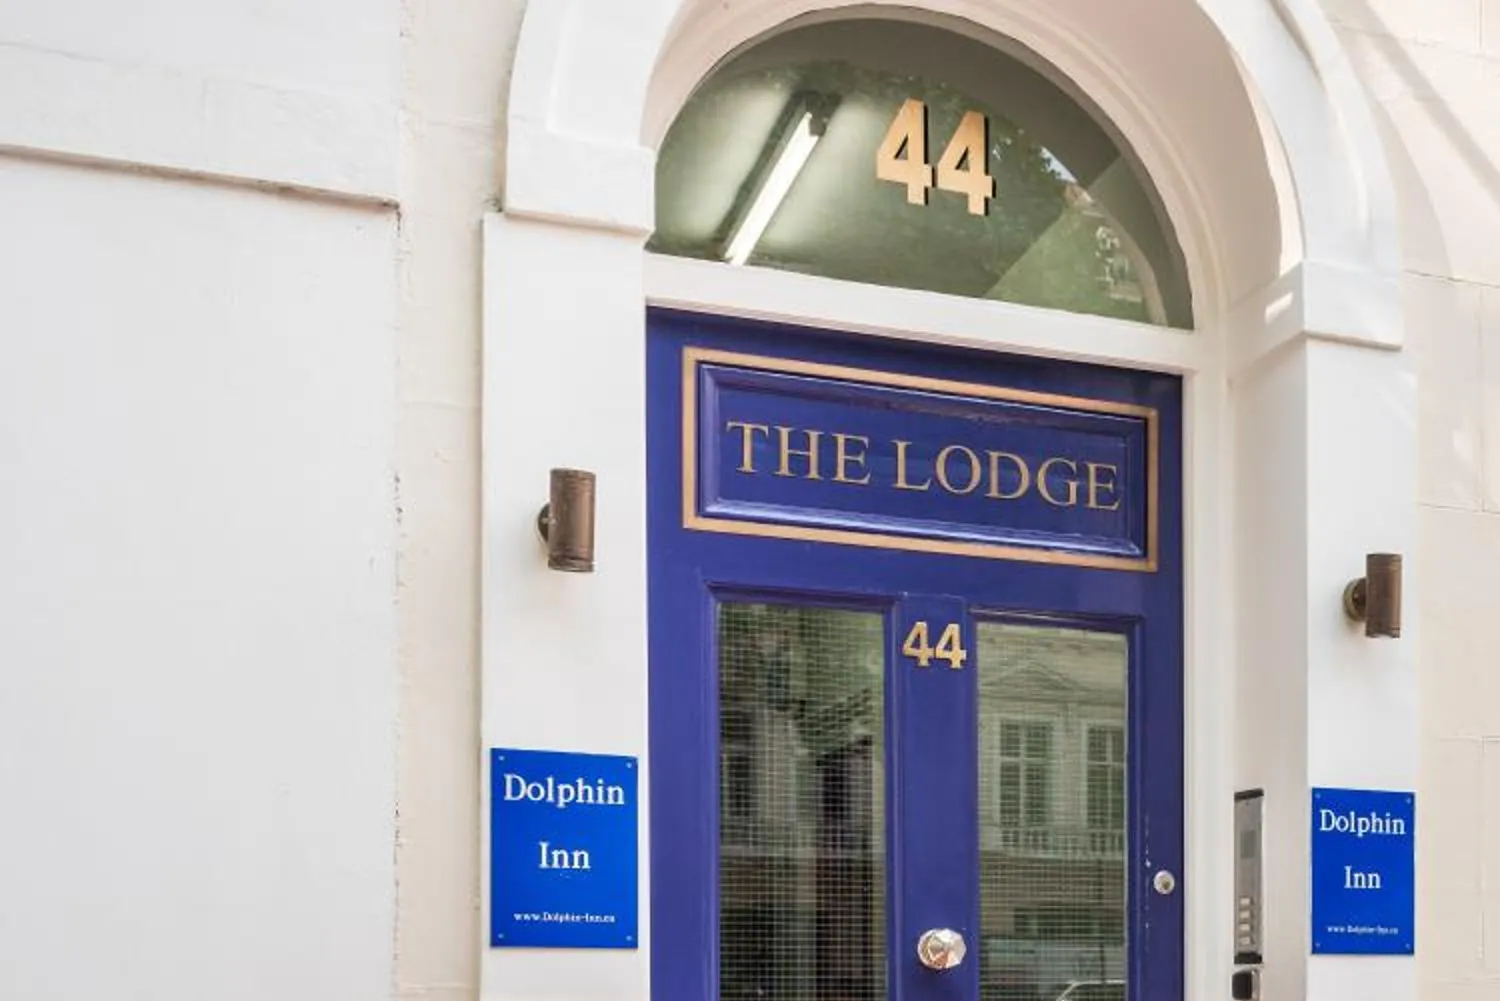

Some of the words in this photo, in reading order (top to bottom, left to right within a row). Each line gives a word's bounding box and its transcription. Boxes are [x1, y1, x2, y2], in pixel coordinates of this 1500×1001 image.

[876, 97, 994, 216] 44
[726, 420, 872, 485] THE
[891, 440, 1120, 511] LODGE
[902, 621, 967, 669] 44
[503, 773, 625, 809] Dolphin
[1319, 809, 1406, 838] Dolphin
[538, 841, 591, 869] Inn
[1344, 865, 1382, 889] Inn
